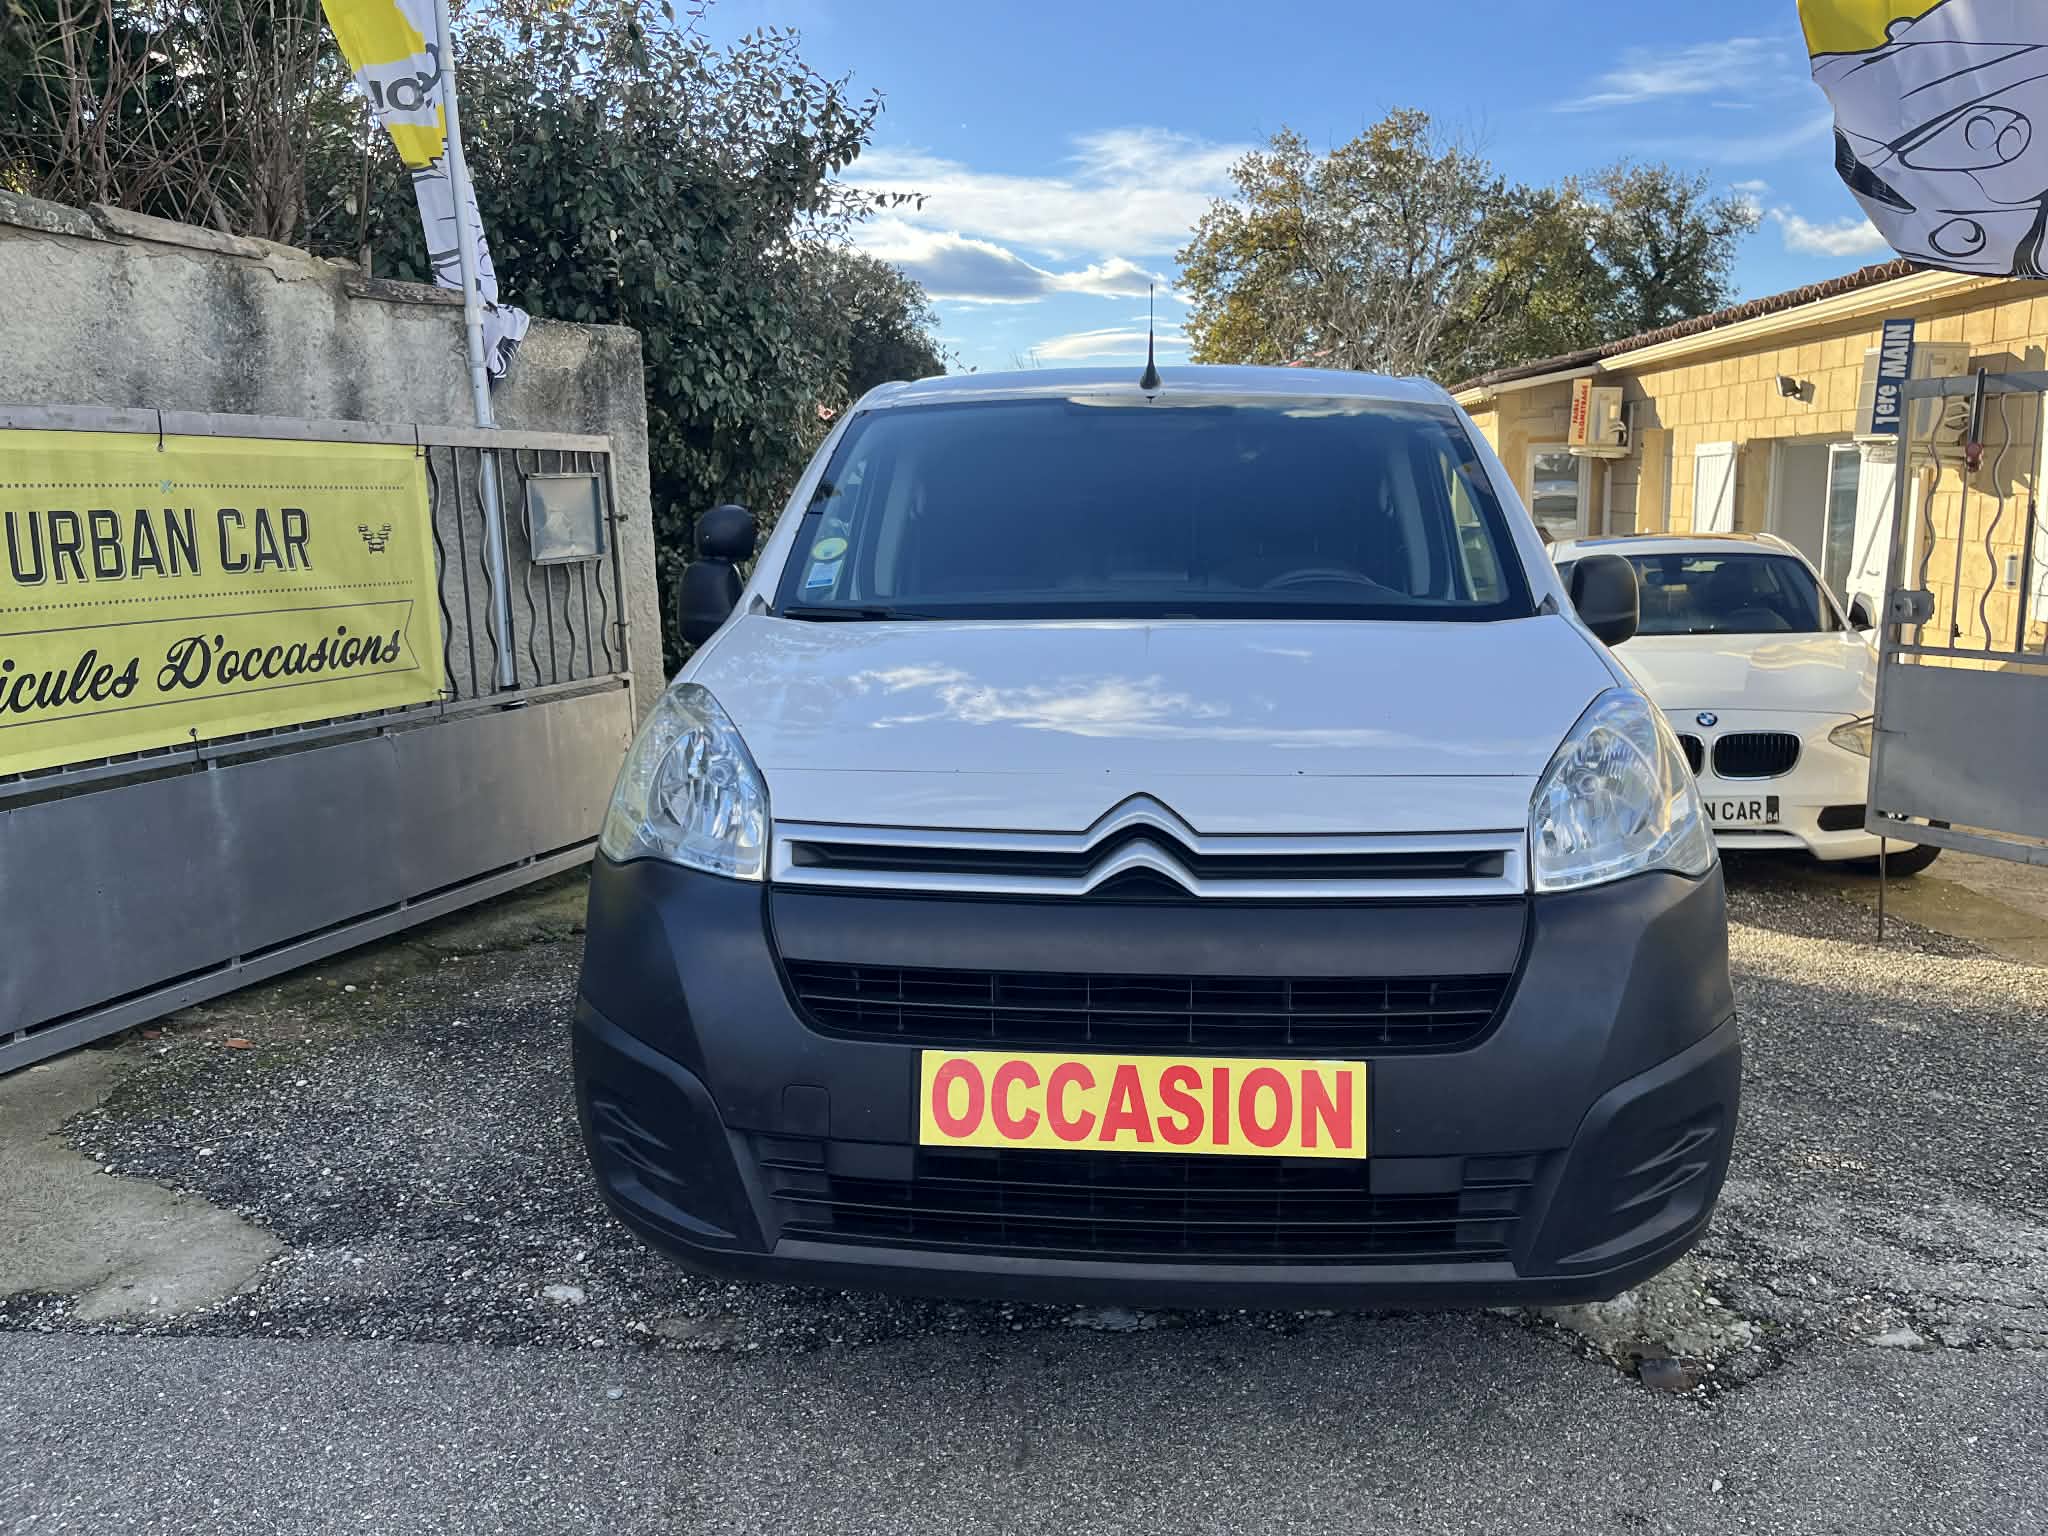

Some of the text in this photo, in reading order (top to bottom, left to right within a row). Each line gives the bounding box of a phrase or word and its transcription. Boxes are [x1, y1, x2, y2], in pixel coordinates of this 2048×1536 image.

[1881, 325, 1911, 378] MAIN
[4, 507, 313, 586] URBAN CAR
[157, 625, 401, 692] D'occasions
[1722, 800, 1762, 821] CAR
[931, 1058, 1353, 1149] OCCASION
